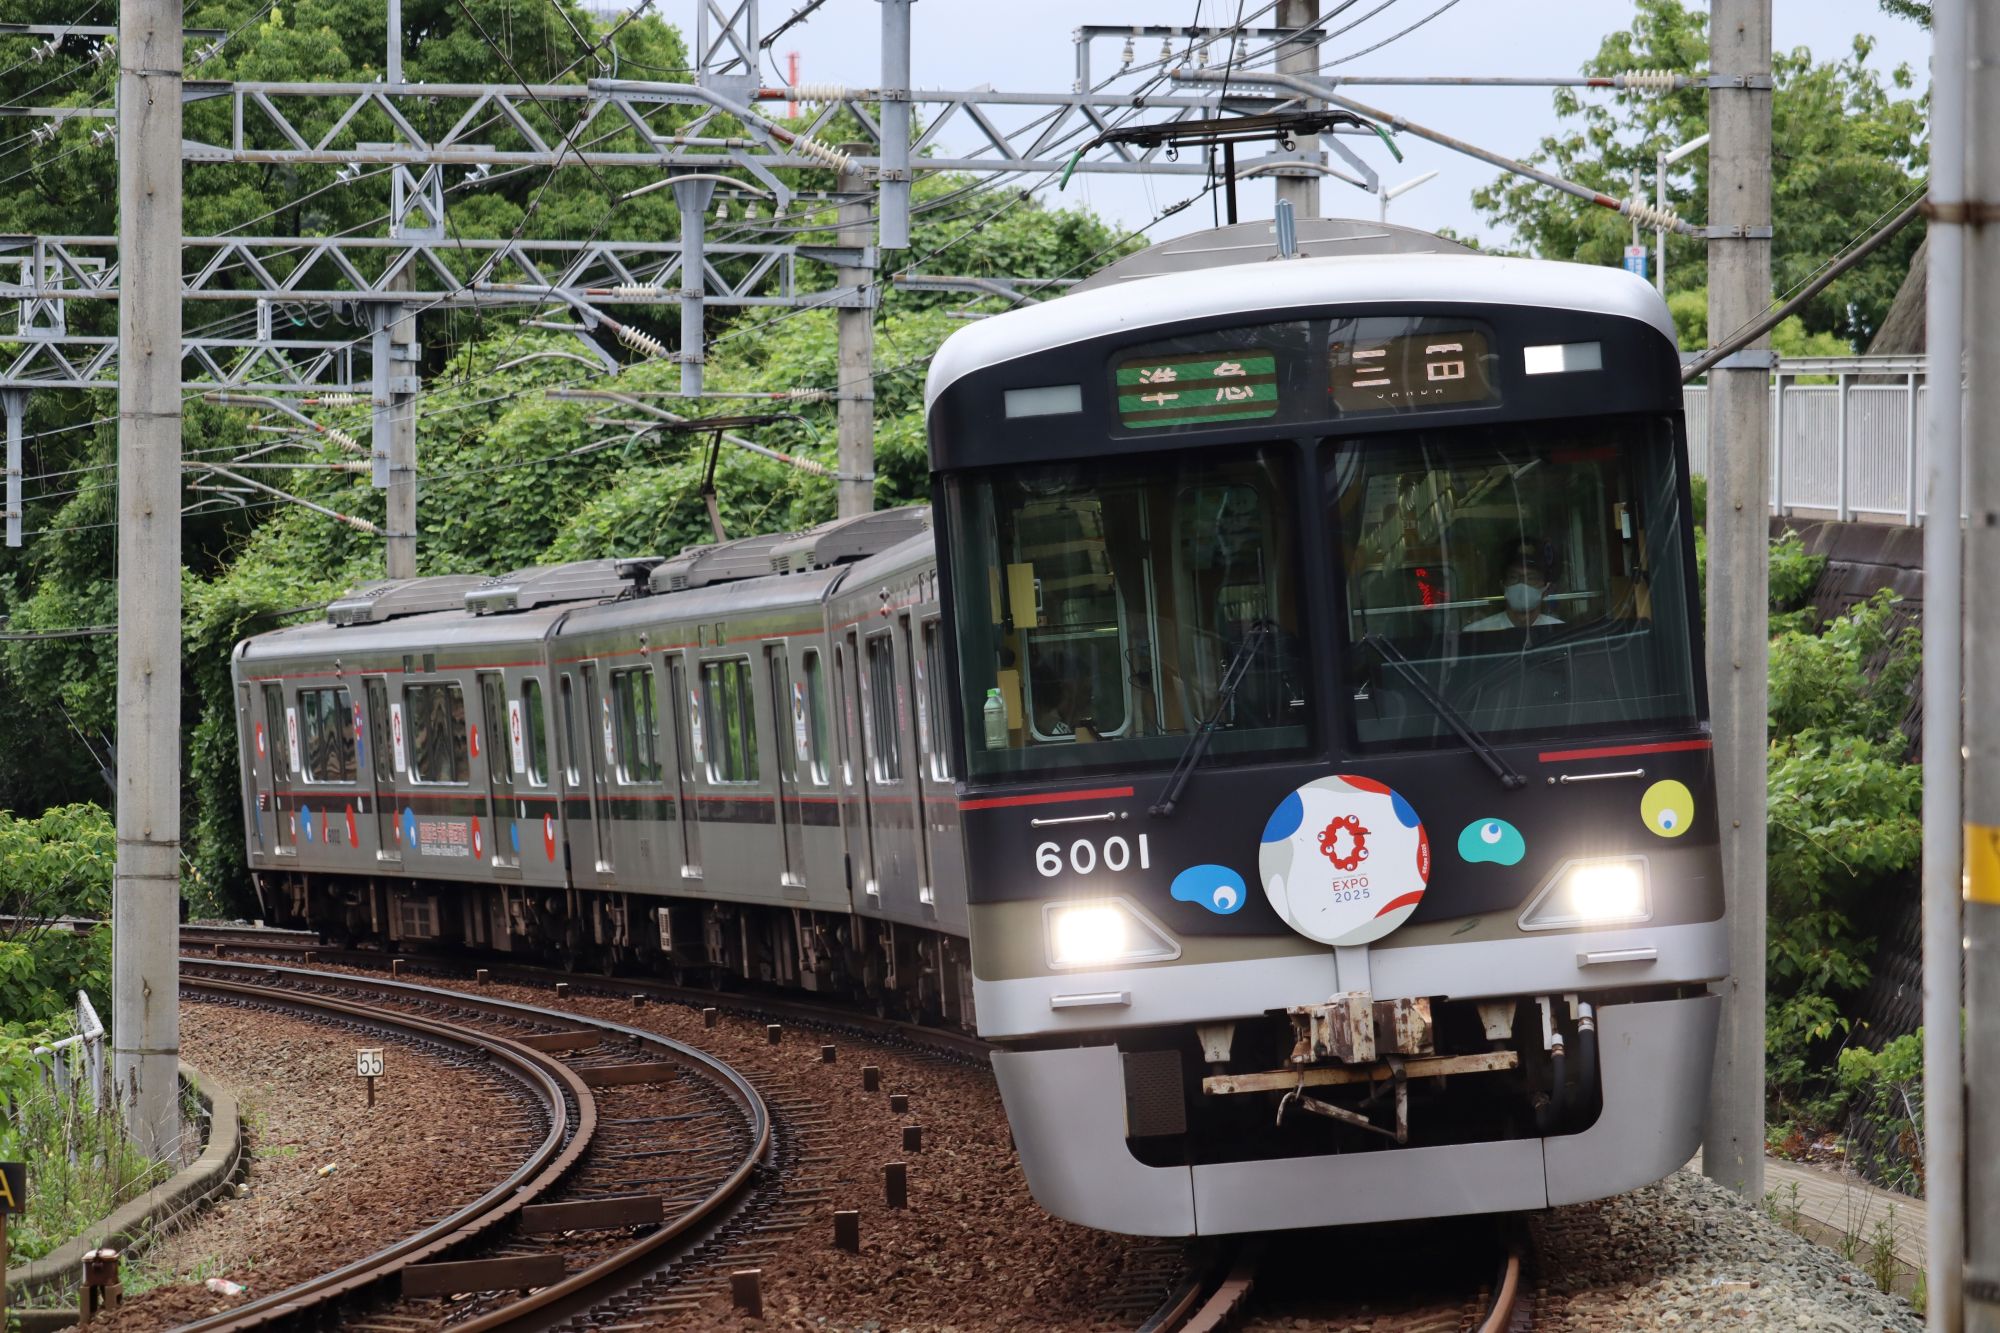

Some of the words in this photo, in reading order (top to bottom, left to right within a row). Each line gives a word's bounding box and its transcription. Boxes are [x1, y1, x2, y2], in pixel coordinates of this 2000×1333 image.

[1035, 833, 1150, 877] 6001
[1332, 877, 1369, 892] EXPO
[1335, 888, 1370, 903] 2025
[360, 1051, 382, 1075] 55
